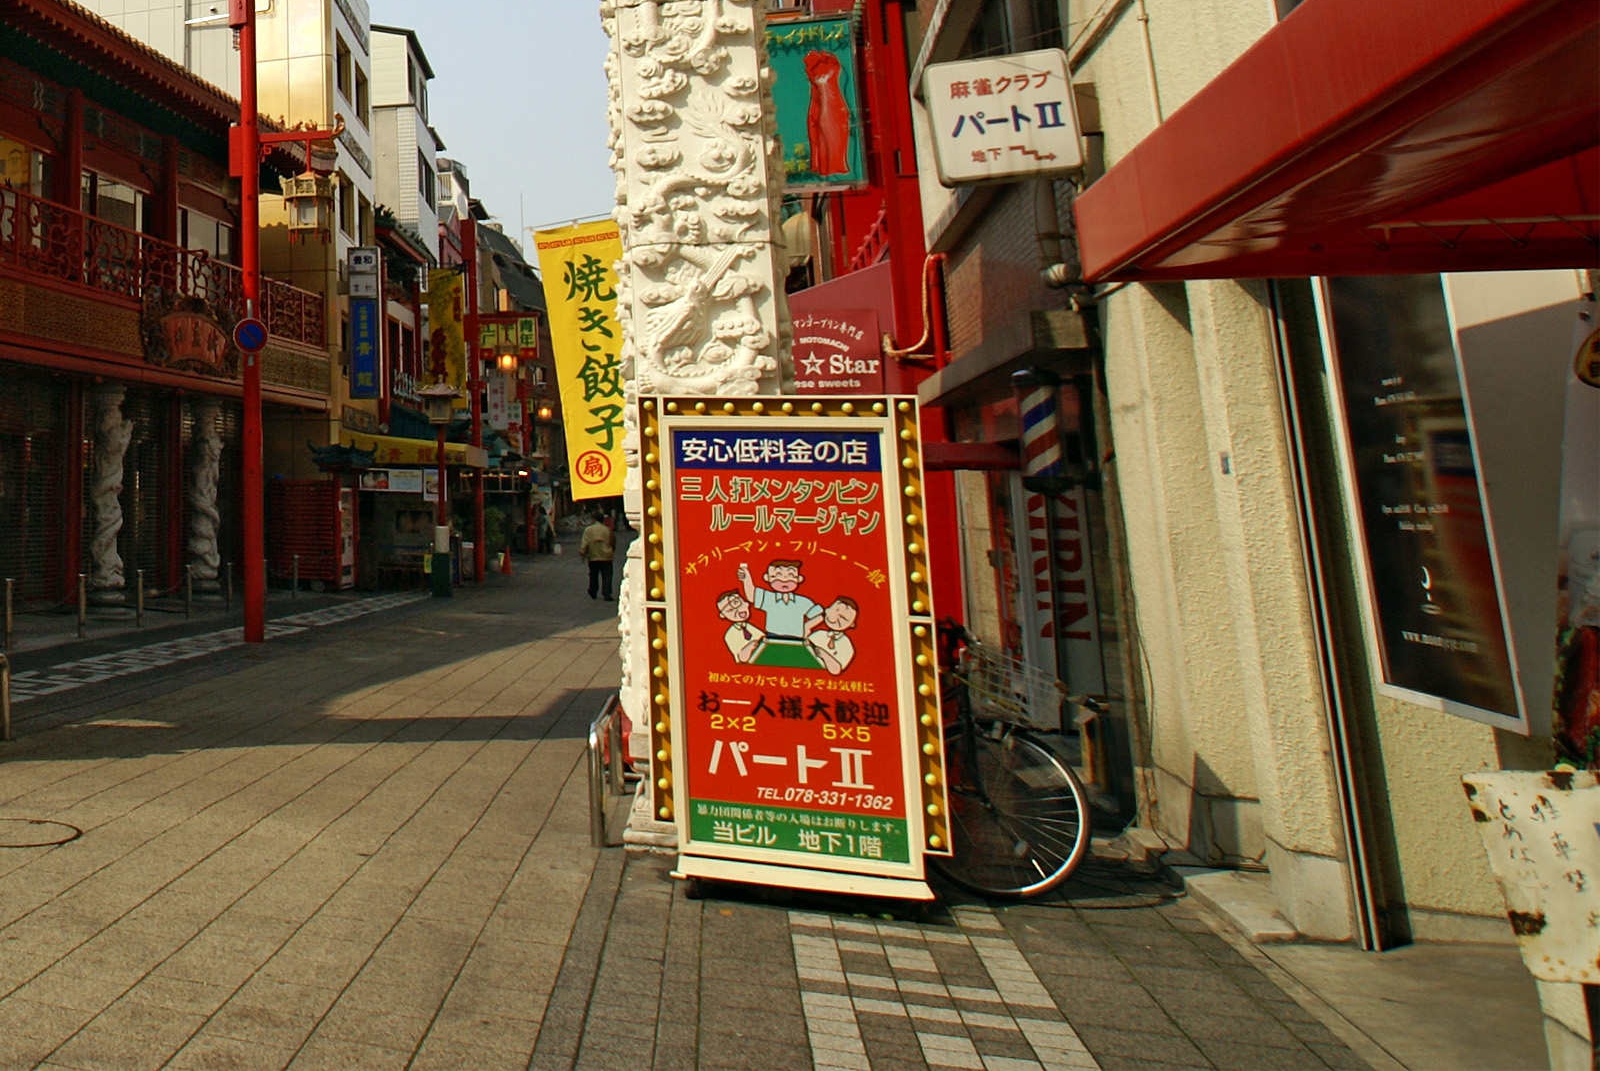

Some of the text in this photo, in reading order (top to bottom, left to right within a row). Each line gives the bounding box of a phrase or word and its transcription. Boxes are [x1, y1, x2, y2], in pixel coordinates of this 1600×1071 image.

[950, 70, 1052, 99] 麻雀クラブ
[971, 147, 1001, 163] 地下
[563, 254, 625, 452] 焼き餃子
[799, 336, 850, 352] MOTOMACHI
[829, 354, 880, 375] Star
[818, 379, 861, 388] sweets
[682, 437, 868, 464] 安心低料金の店
[680, 476, 879, 504] 三人打メンタンピン
[709, 504, 880, 536] ルールマージャン
[708, 671, 875, 693] 初めての方でもどうぞお気軽に
[712, 820, 883, 859] 当ビル 地下1階
